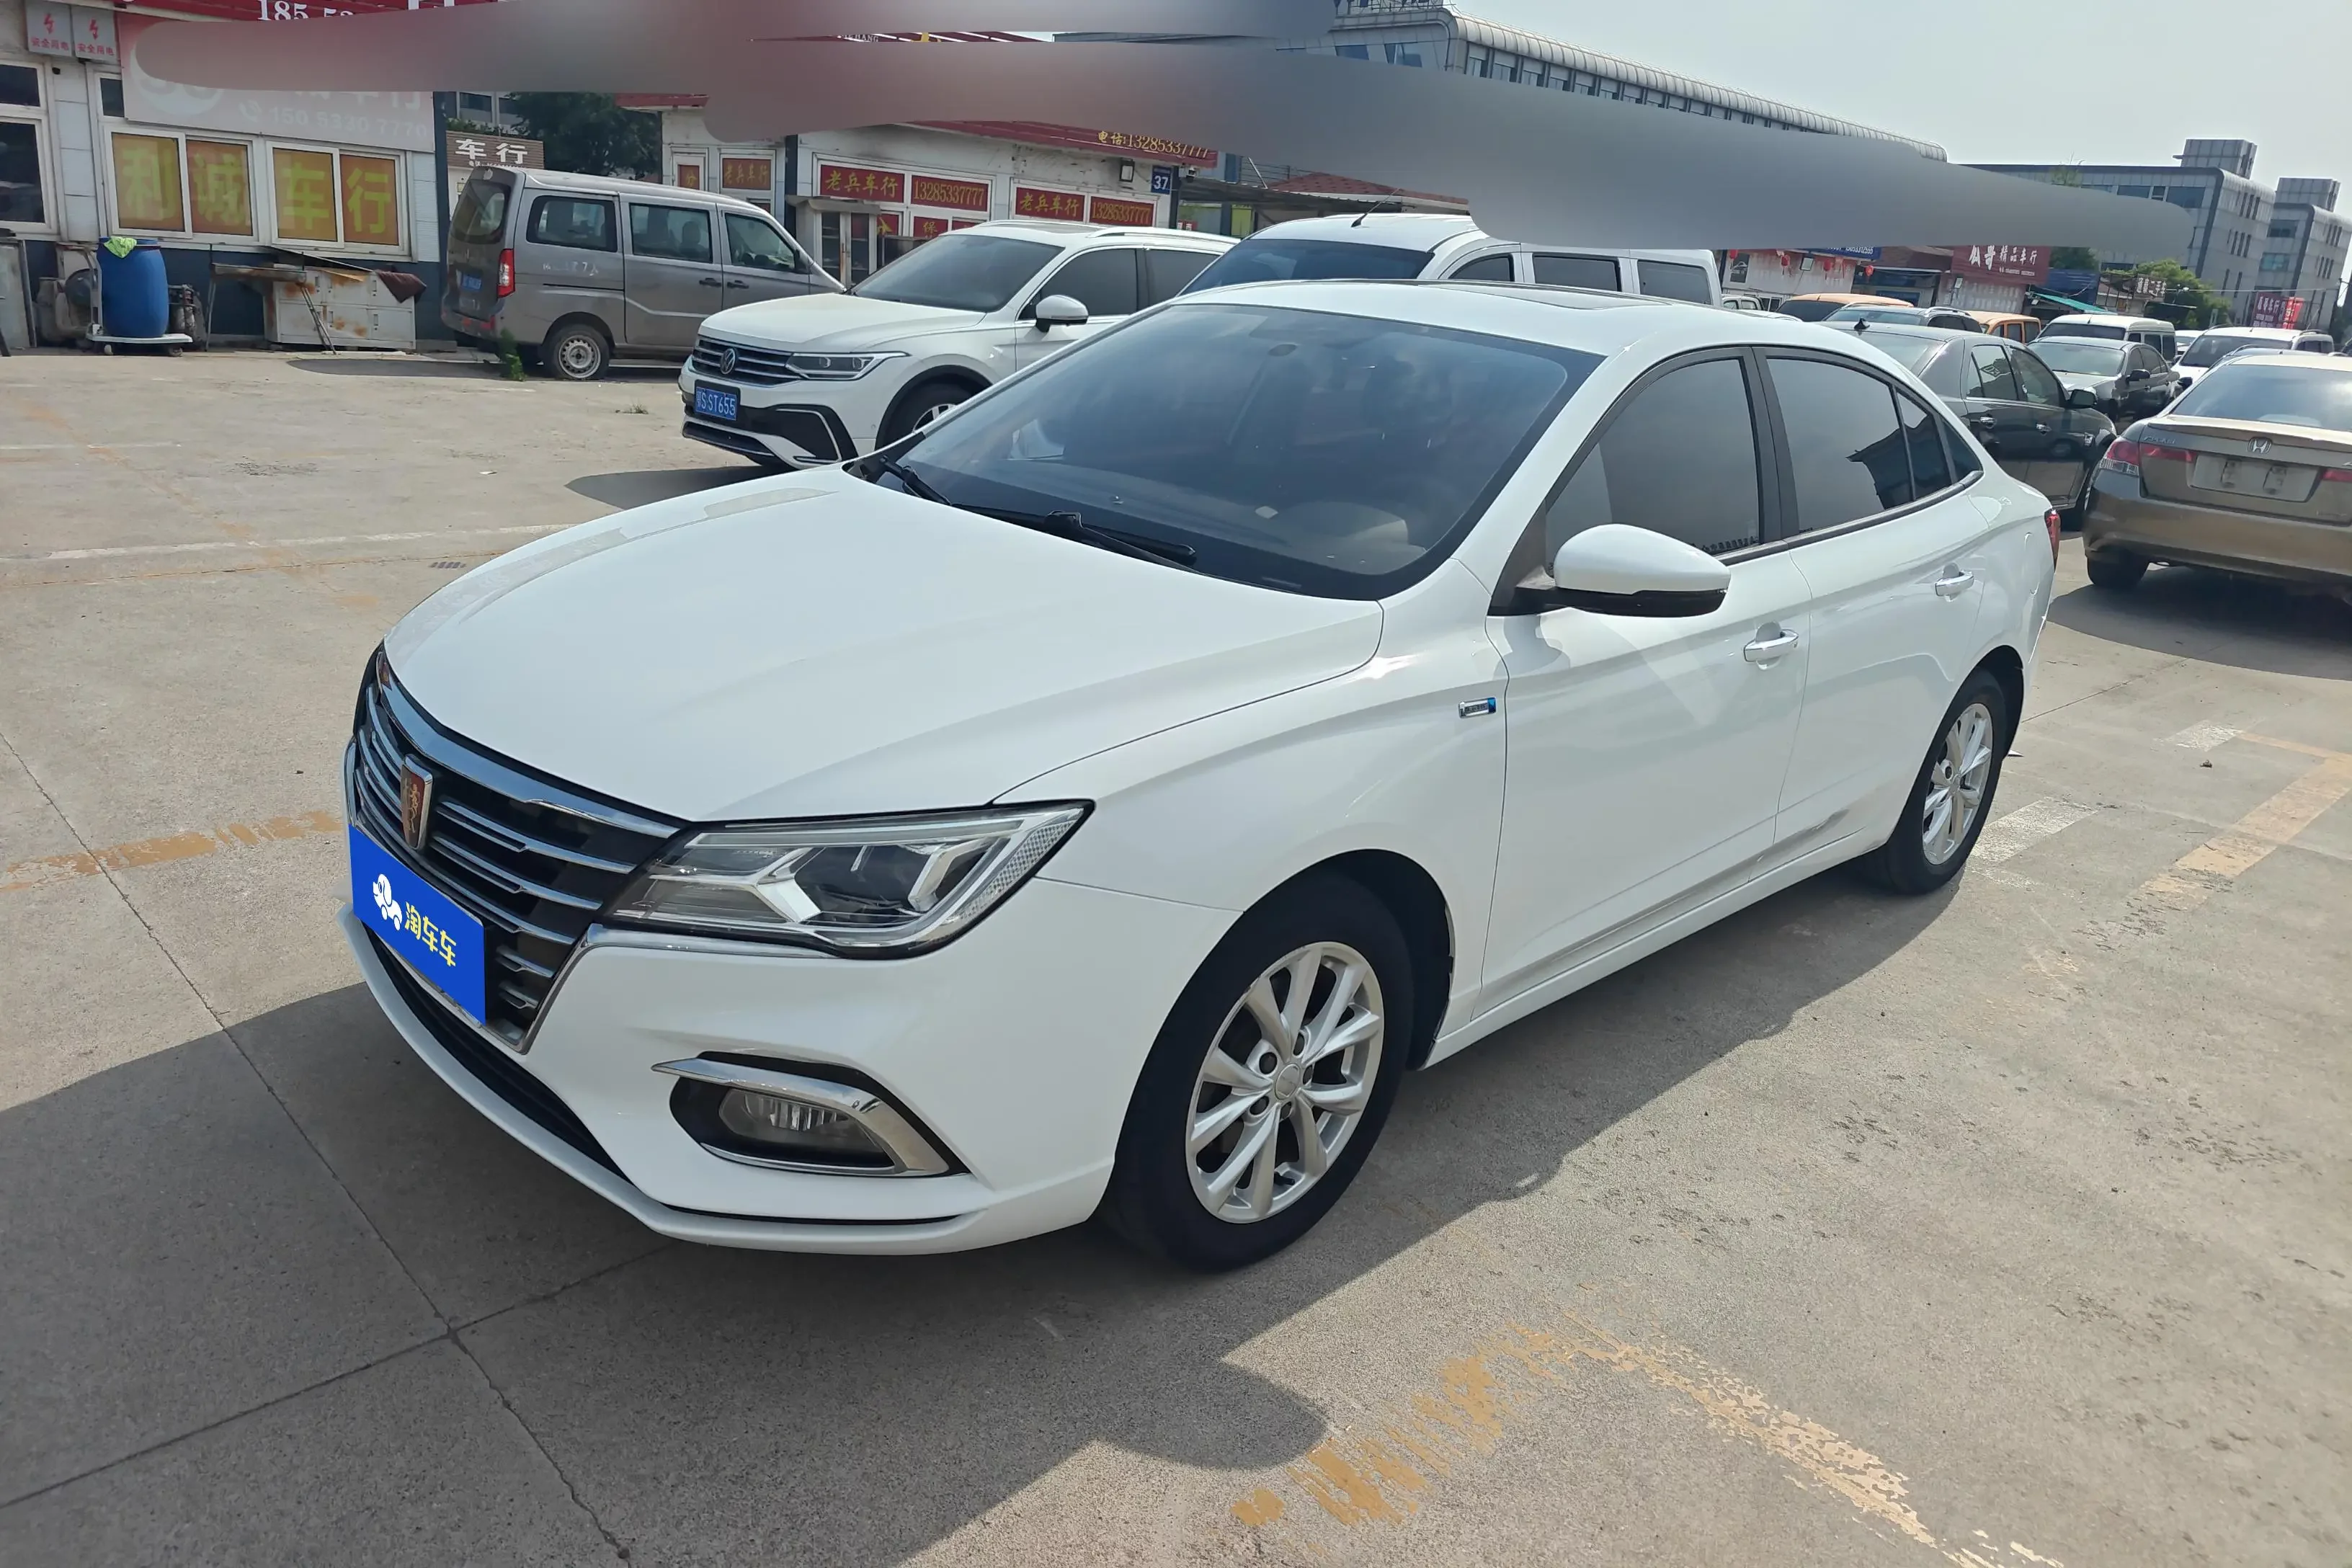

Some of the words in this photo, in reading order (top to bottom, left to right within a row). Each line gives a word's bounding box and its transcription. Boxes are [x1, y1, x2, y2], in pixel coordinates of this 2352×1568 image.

[76, 43, 115, 55] 安全用电
[455, 138, 528, 164] 车行
[825, 169, 899, 198] 老兵车行
[913, 180, 984, 207] 13285337777
[1153, 174, 1168, 190] 37
[1019, 192, 1079, 217] 老兵车行
